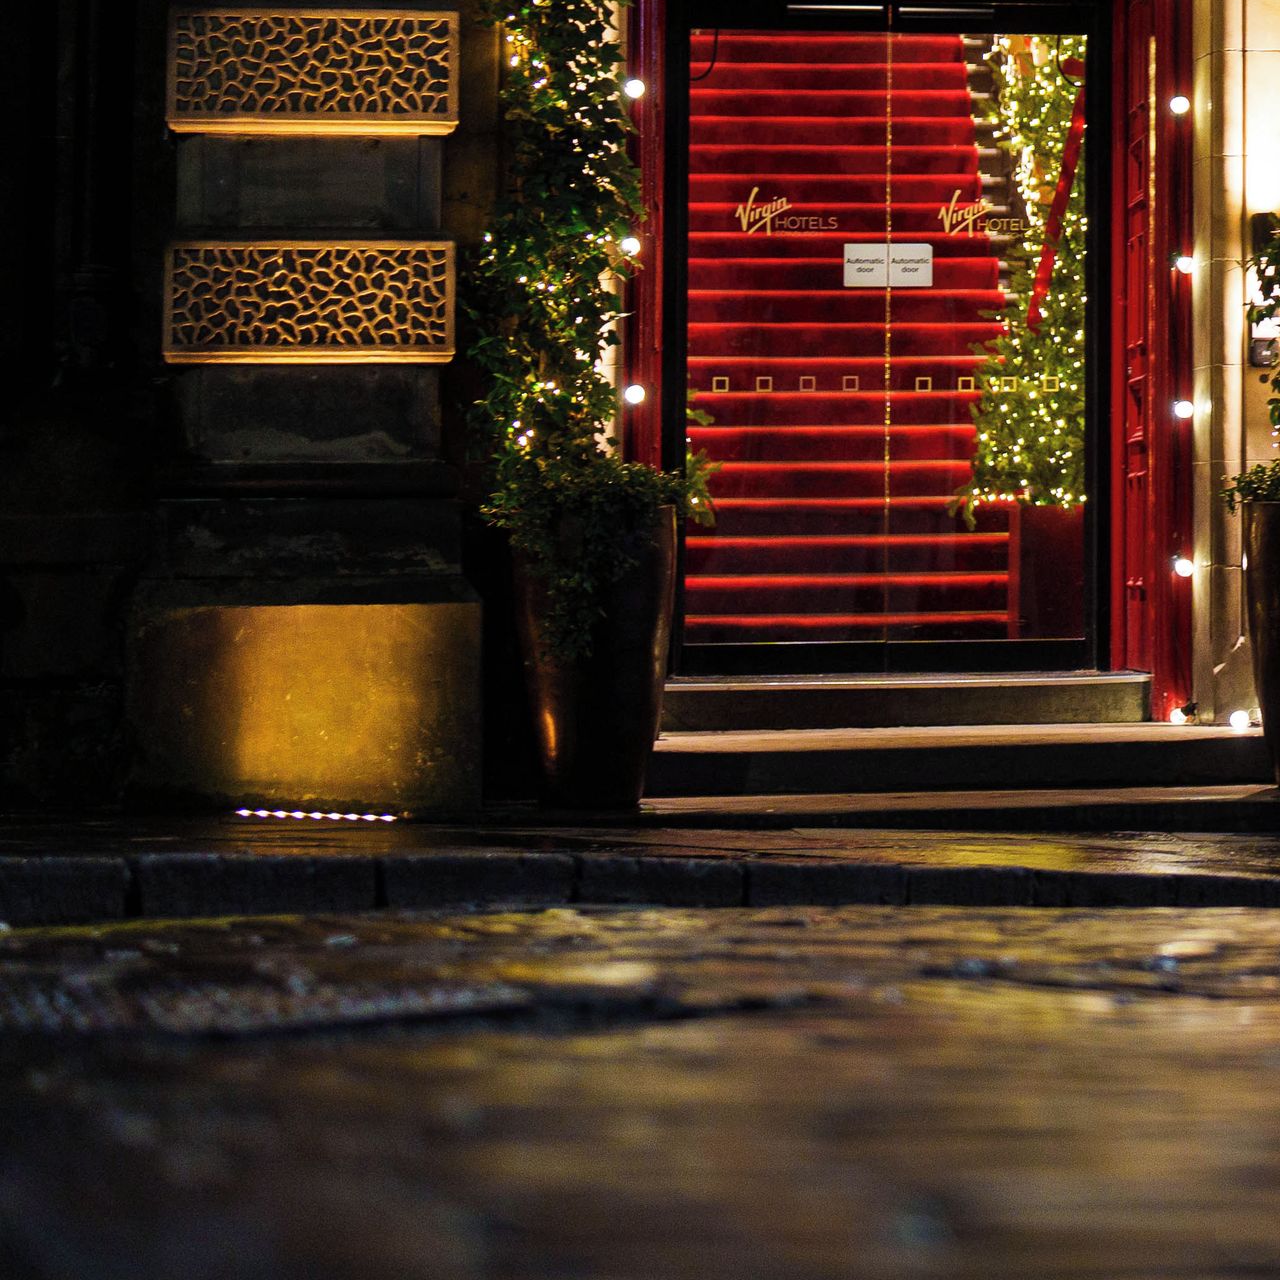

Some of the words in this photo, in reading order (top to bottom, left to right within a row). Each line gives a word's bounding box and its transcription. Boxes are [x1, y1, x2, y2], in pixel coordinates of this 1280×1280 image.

[734, 186, 793, 237] Virgin
[774, 216, 839, 230] HOTELS
[976, 218, 1041, 232] HOTEL
[846, 257, 886, 265] Automatic
[891, 257, 931, 265] Automatic
